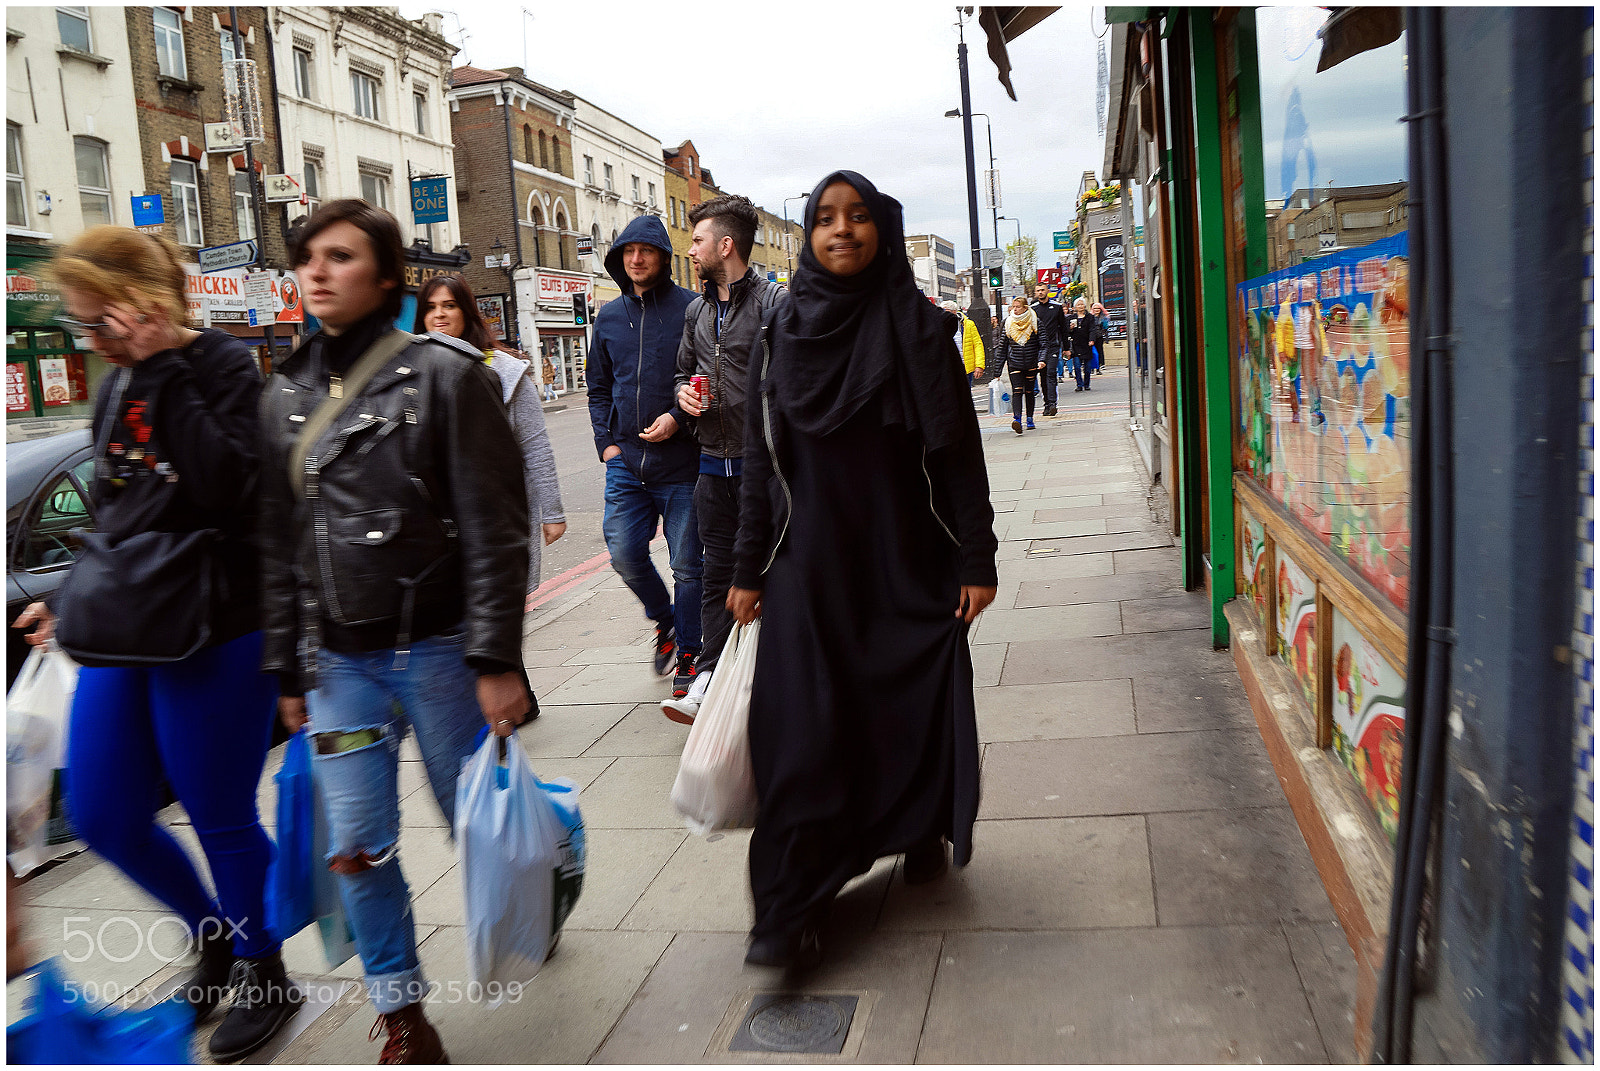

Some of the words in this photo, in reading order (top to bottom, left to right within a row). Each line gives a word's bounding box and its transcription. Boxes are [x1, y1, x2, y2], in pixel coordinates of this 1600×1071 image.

[413, 186, 429, 198] BE
[433, 184, 445, 193] AT
[415, 196, 446, 211] ONE
[404, 266, 420, 287] BE
[185, 274, 239, 296] HICKEN
[541, 278, 562, 292] SUITS
[564, 280, 588, 293] DIRECT
